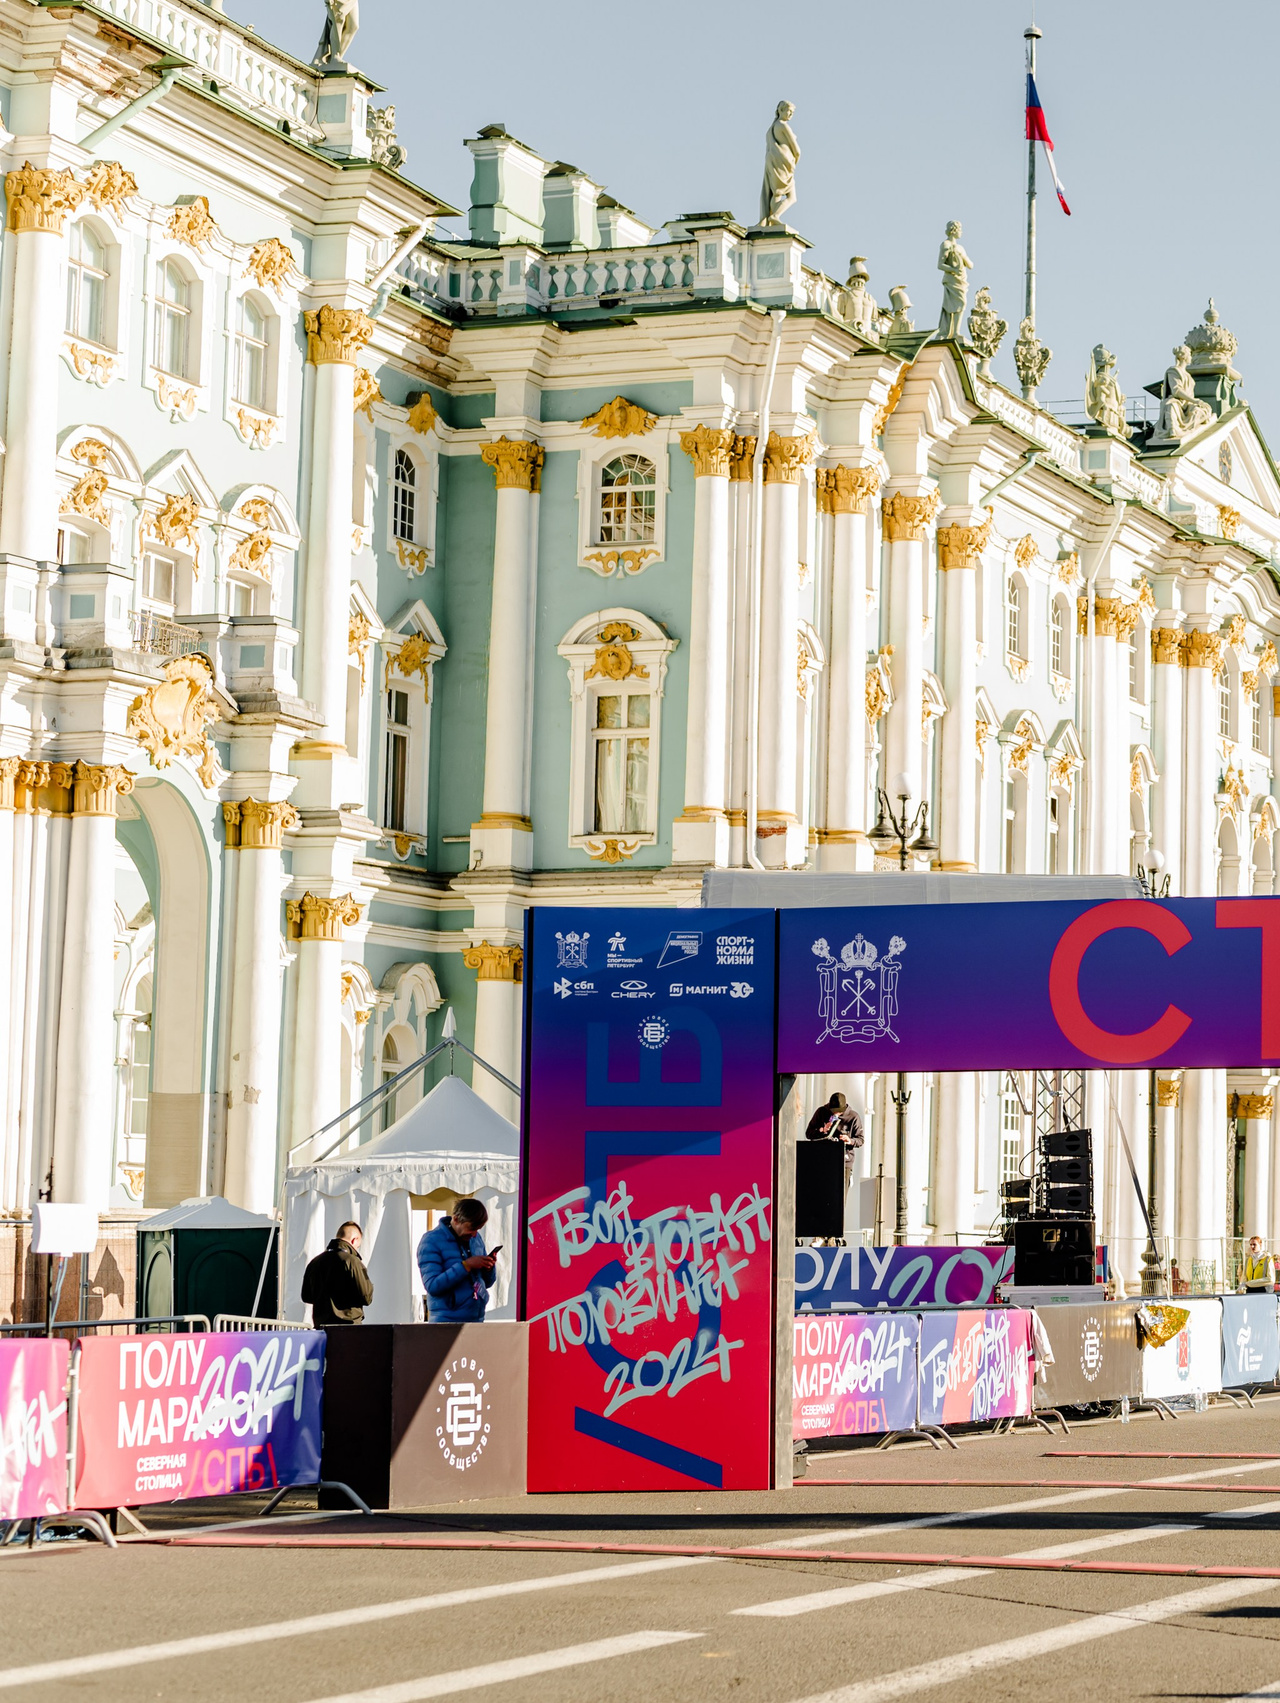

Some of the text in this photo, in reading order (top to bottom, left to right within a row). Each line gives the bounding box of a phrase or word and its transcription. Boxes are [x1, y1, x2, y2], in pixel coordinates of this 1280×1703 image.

[716, 936, 748, 946] СПОРТ
[716, 945, 754, 955] НОРМА
[716, 955, 754, 965] ЖИЗНИ
[574, 980, 594, 990] сбп
[685, 985, 728, 994] МАГНИТ
[611, 991, 656, 999] CHERY
[638, 1015, 670, 1028] БЕГОВОЕ
[793, 1320, 912, 1396] ПОЛУ 2024
[438, 1356, 490, 1396] БЕГОВОЕ
[603, 1334, 745, 1418] 2024
[119, 1336, 321, 1443] ПОЛУ 2024
[801, 1402, 835, 1416] СЕВЕРНАЯ
[436, 1422, 491, 1472] СООБЩЕСТВО
[136, 1452, 187, 1473] СЕВЕРНАЯ
[135, 1471, 183, 1493] СТОЛИЦА
